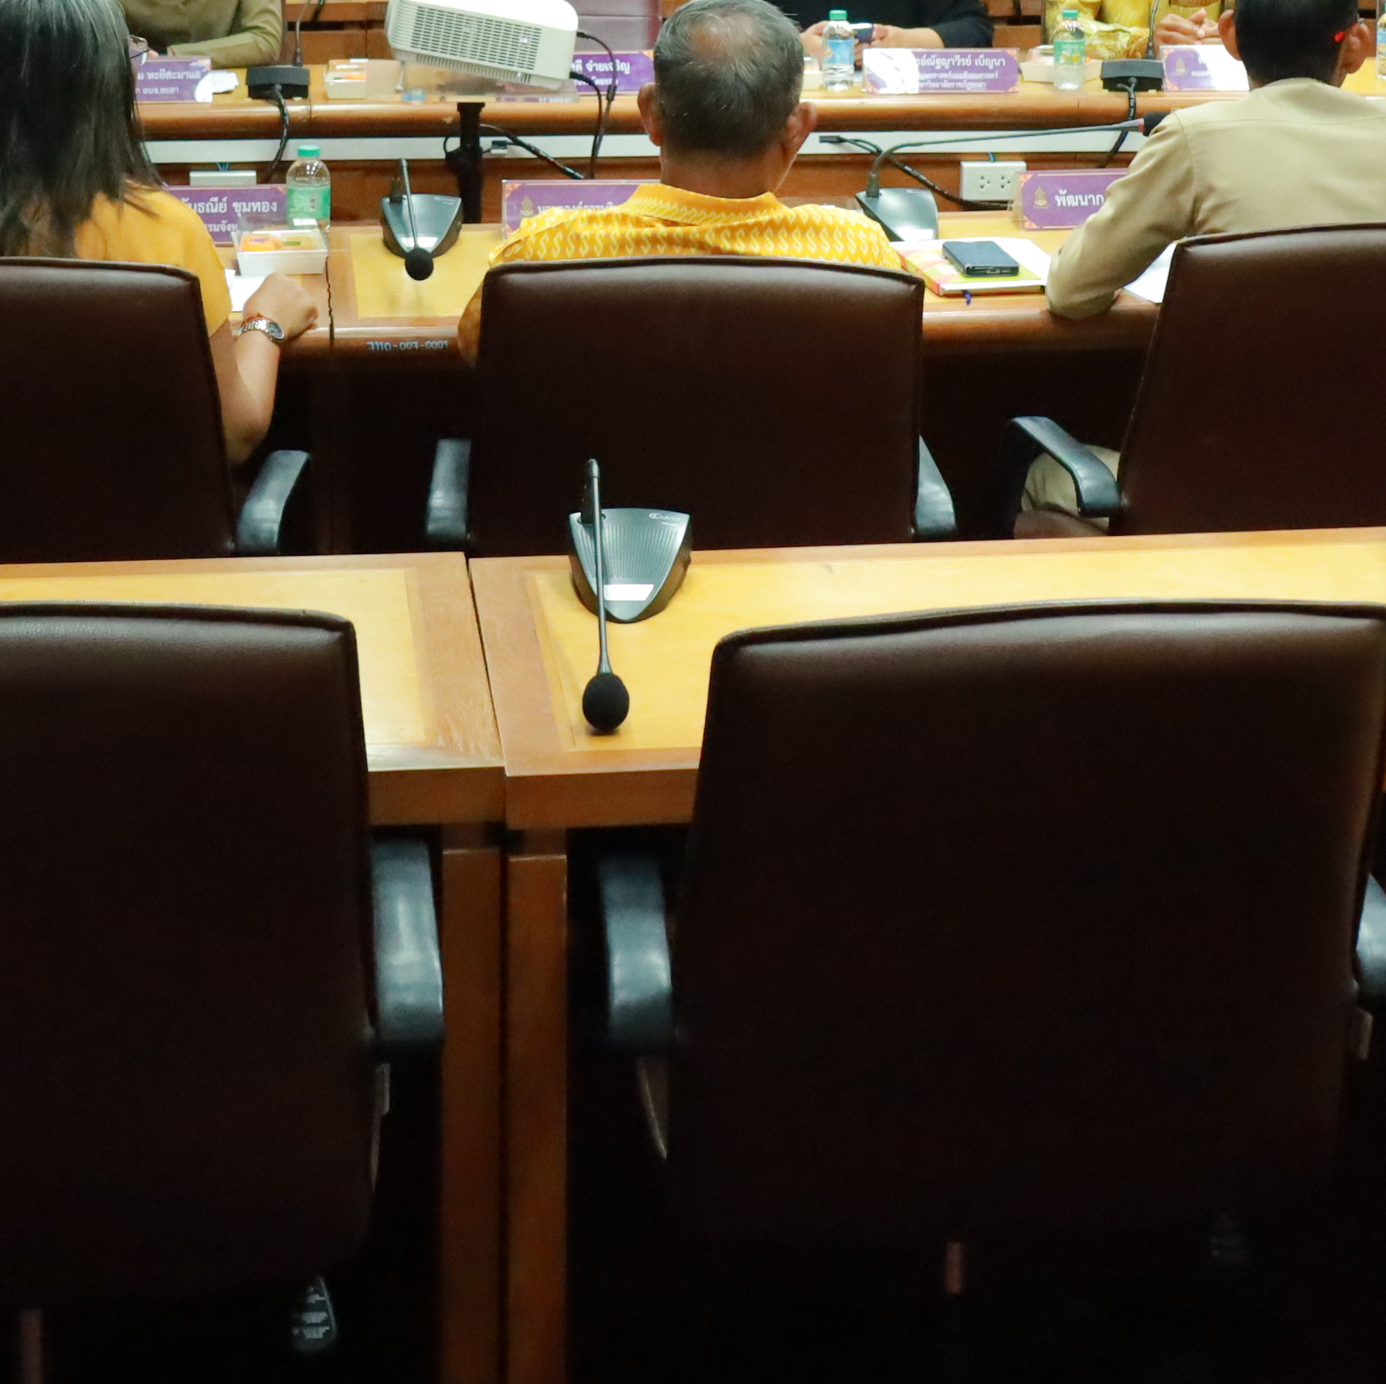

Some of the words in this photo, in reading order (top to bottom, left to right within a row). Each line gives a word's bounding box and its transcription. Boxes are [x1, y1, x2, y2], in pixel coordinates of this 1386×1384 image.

[1054, 188, 1105, 208] พัฒนาก
[231, 199, 278, 217] ชุมทอง
